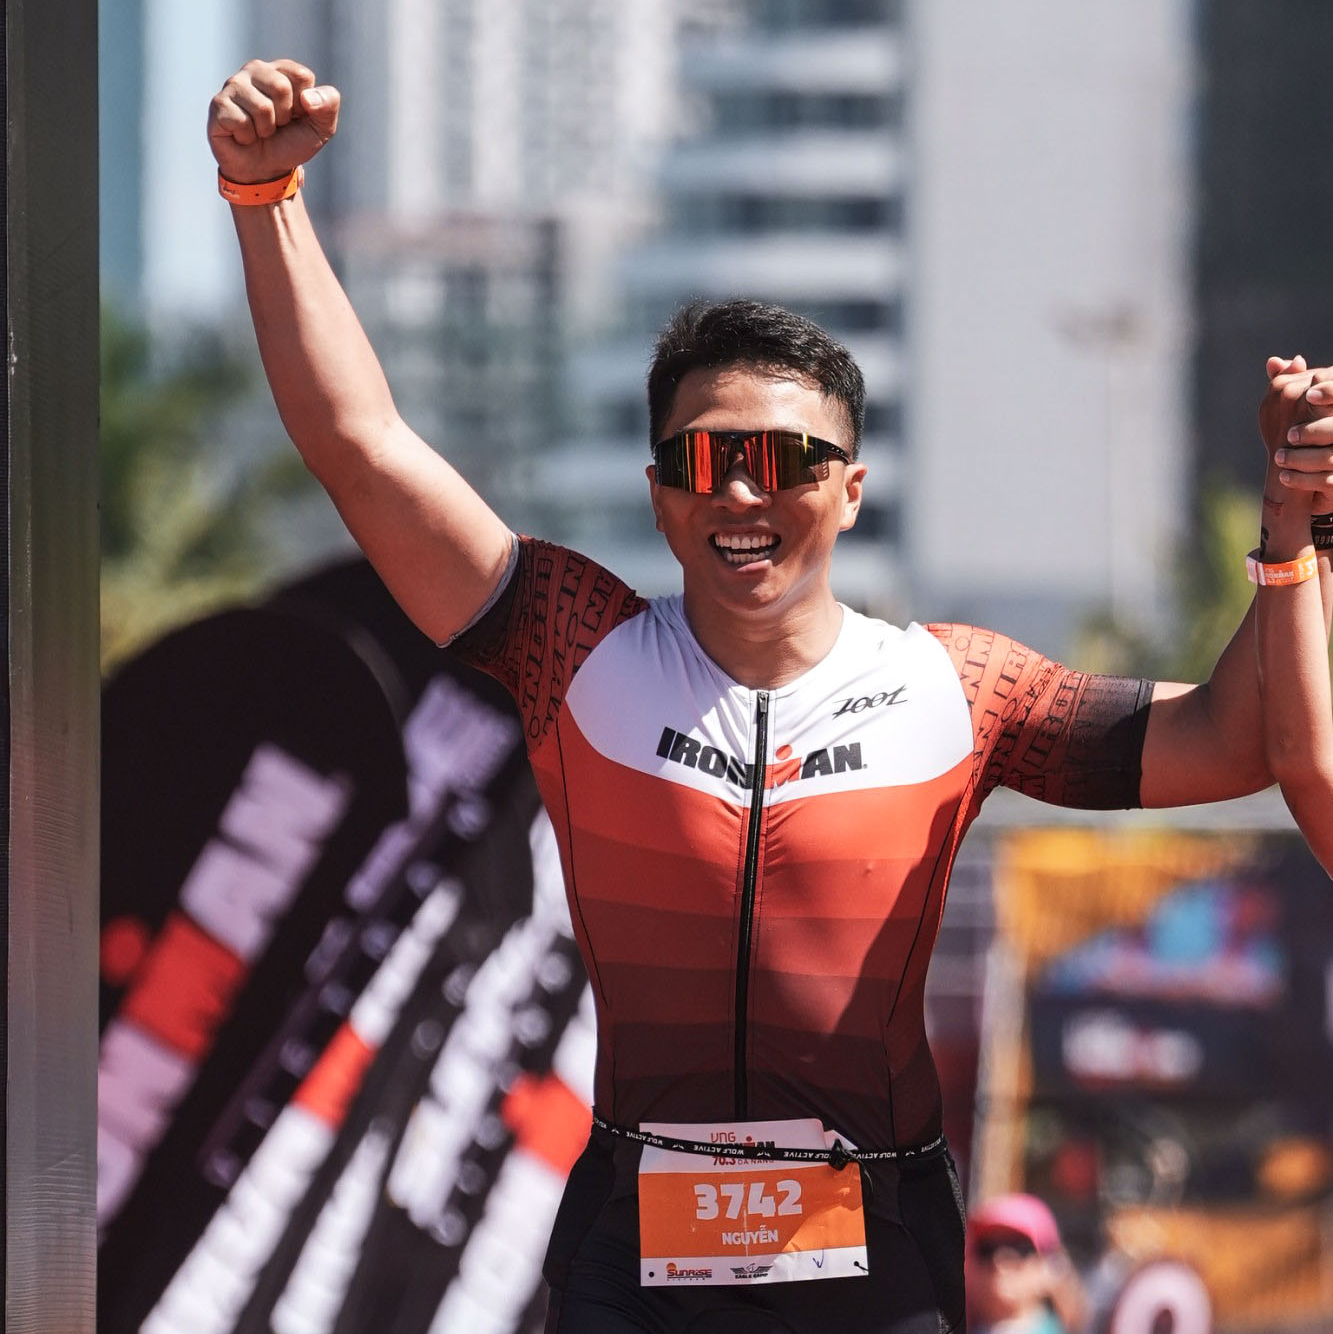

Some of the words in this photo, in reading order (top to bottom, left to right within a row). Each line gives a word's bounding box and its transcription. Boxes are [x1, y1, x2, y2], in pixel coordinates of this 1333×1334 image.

[656, 726, 866, 789] IRONMAN
[693, 1144, 722, 1154] ACTIVE
[722, 1147, 744, 1156] WOLF
[783, 1151, 813, 1159] ACTIVE
[693, 1179, 803, 1221] 3742
[722, 1224, 779, 1245] NGUYỄN
